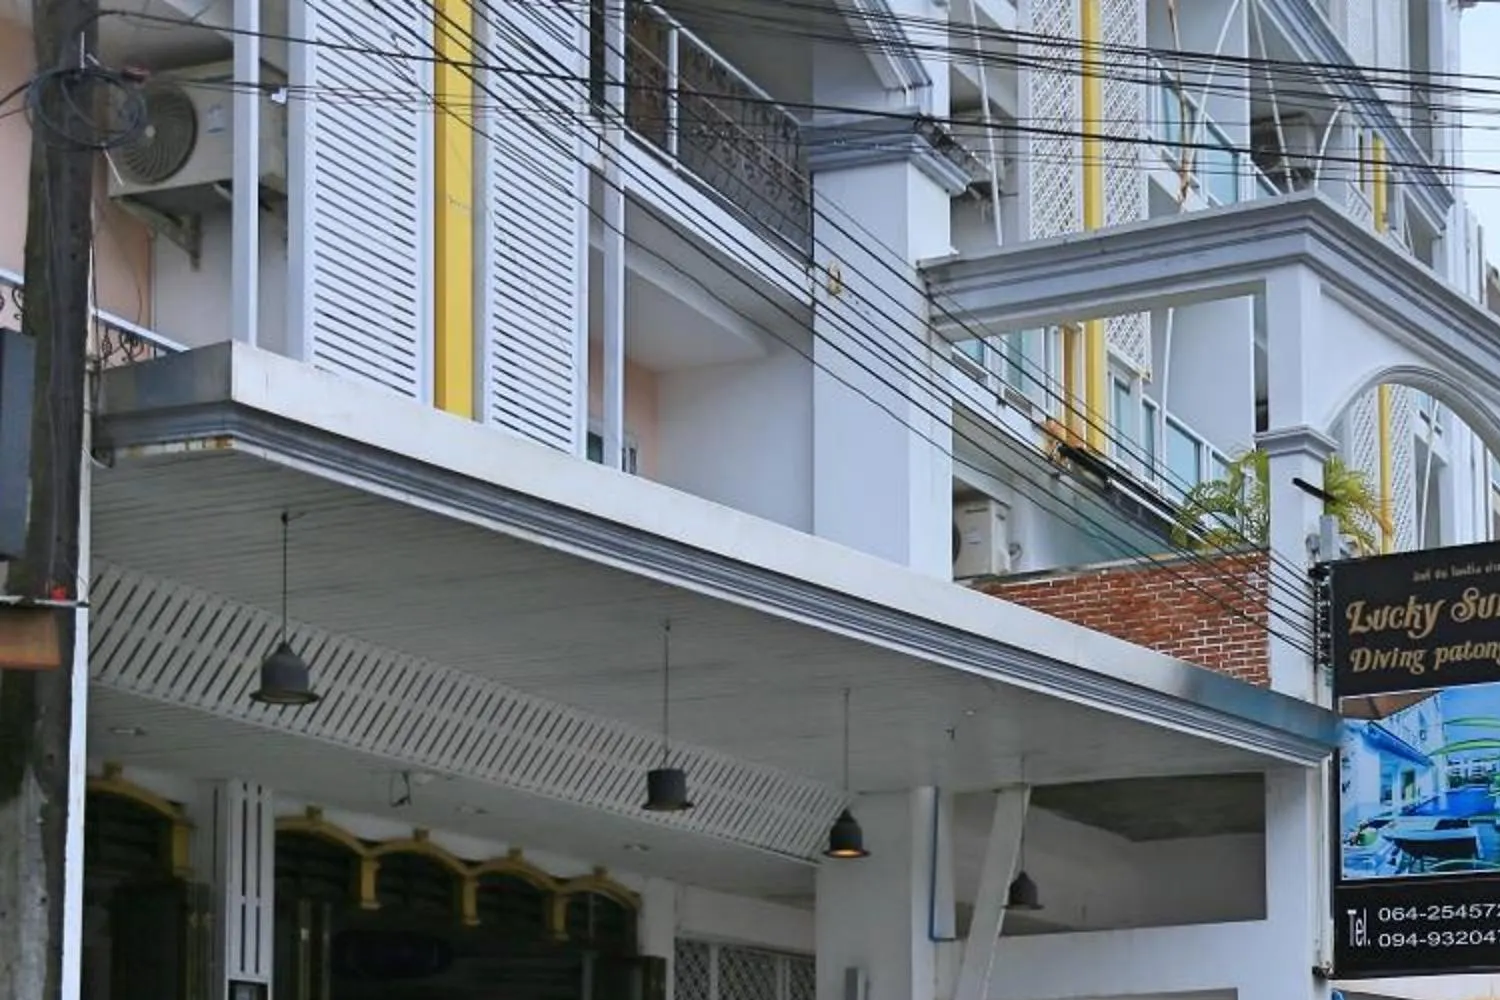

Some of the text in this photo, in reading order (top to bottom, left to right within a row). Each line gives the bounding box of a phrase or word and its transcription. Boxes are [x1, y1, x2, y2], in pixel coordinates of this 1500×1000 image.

[1345, 595, 1447, 640] Lucky
[1350, 647, 1427, 676] Diving
[1347, 907, 1371, 947] Tel.
